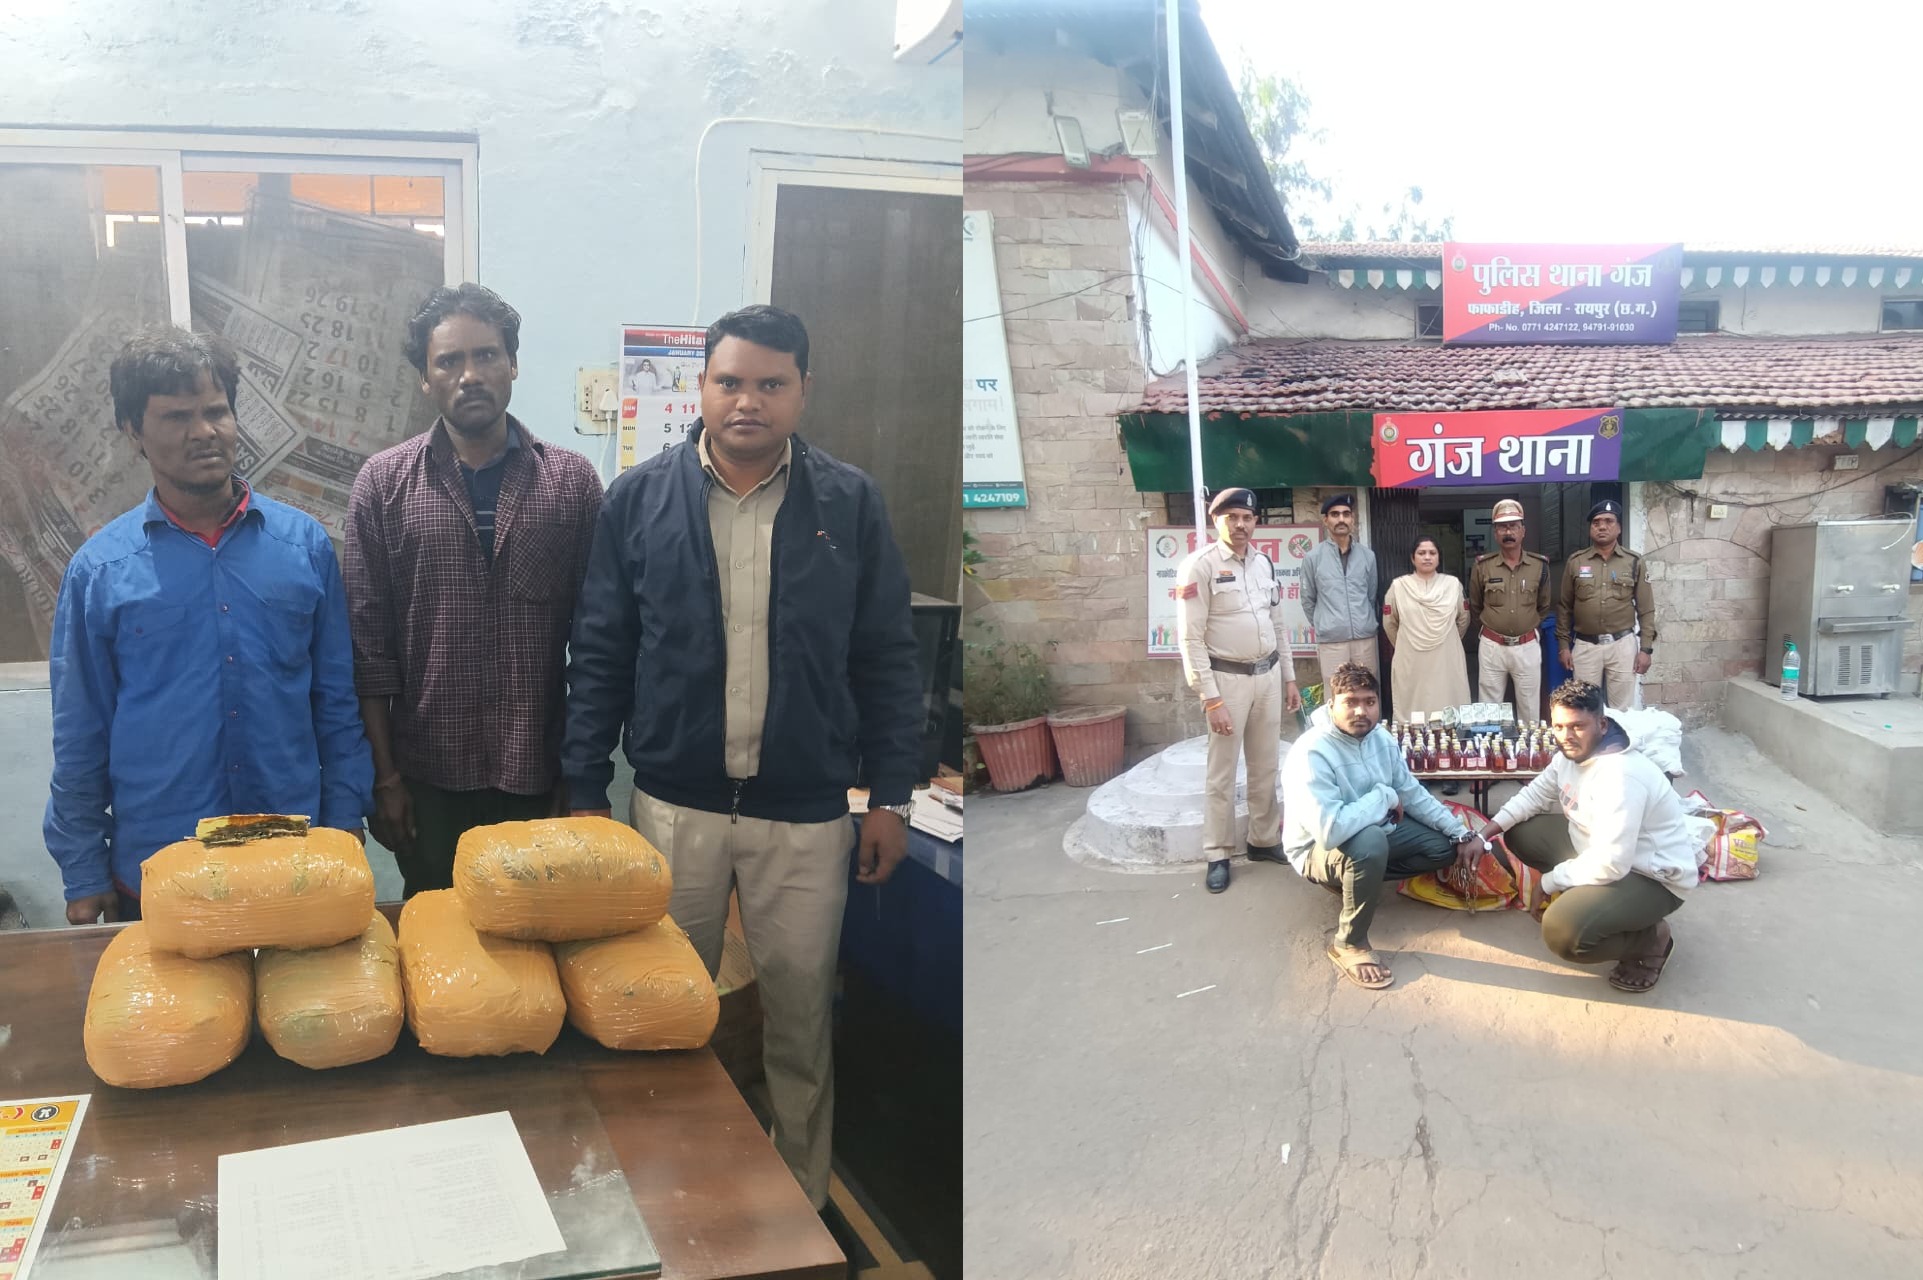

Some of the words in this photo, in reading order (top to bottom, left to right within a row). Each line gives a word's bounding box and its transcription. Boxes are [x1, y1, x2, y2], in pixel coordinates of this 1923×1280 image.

[1472, 256, 1541, 296] पुलिस
[1549, 264, 1602, 288] थाना
[1610, 257, 1653, 288] गंज
[1529, 301, 1562, 315] जिला
[1574, 302, 1611, 318] रायपुर
[1613, 300, 1657, 318] (छ.ग.)
[330, 320, 354, 342] 18
[1505, 323, 1519, 331] No.
[1522, 323, 1541, 331] 0771
[1543, 323, 1580, 332] 4247122,
[1582, 323, 1634, 332] 94791-91030
[358, 354, 381, 376] 10
[55, 375, 81, 402] 26
[322, 371, 344, 394] 16
[360, 382, 372, 400] 9
[976, 379, 998, 391] पर
[356, 406, 367, 423] 8
[664, 403, 673, 414] 4
[682, 403, 696, 414] 11
[664, 423, 672, 433] 5
[1406, 422, 1485, 479] गंज
[1498, 434, 1595, 477] थाना
[973, 492, 1020, 503] 4247109
